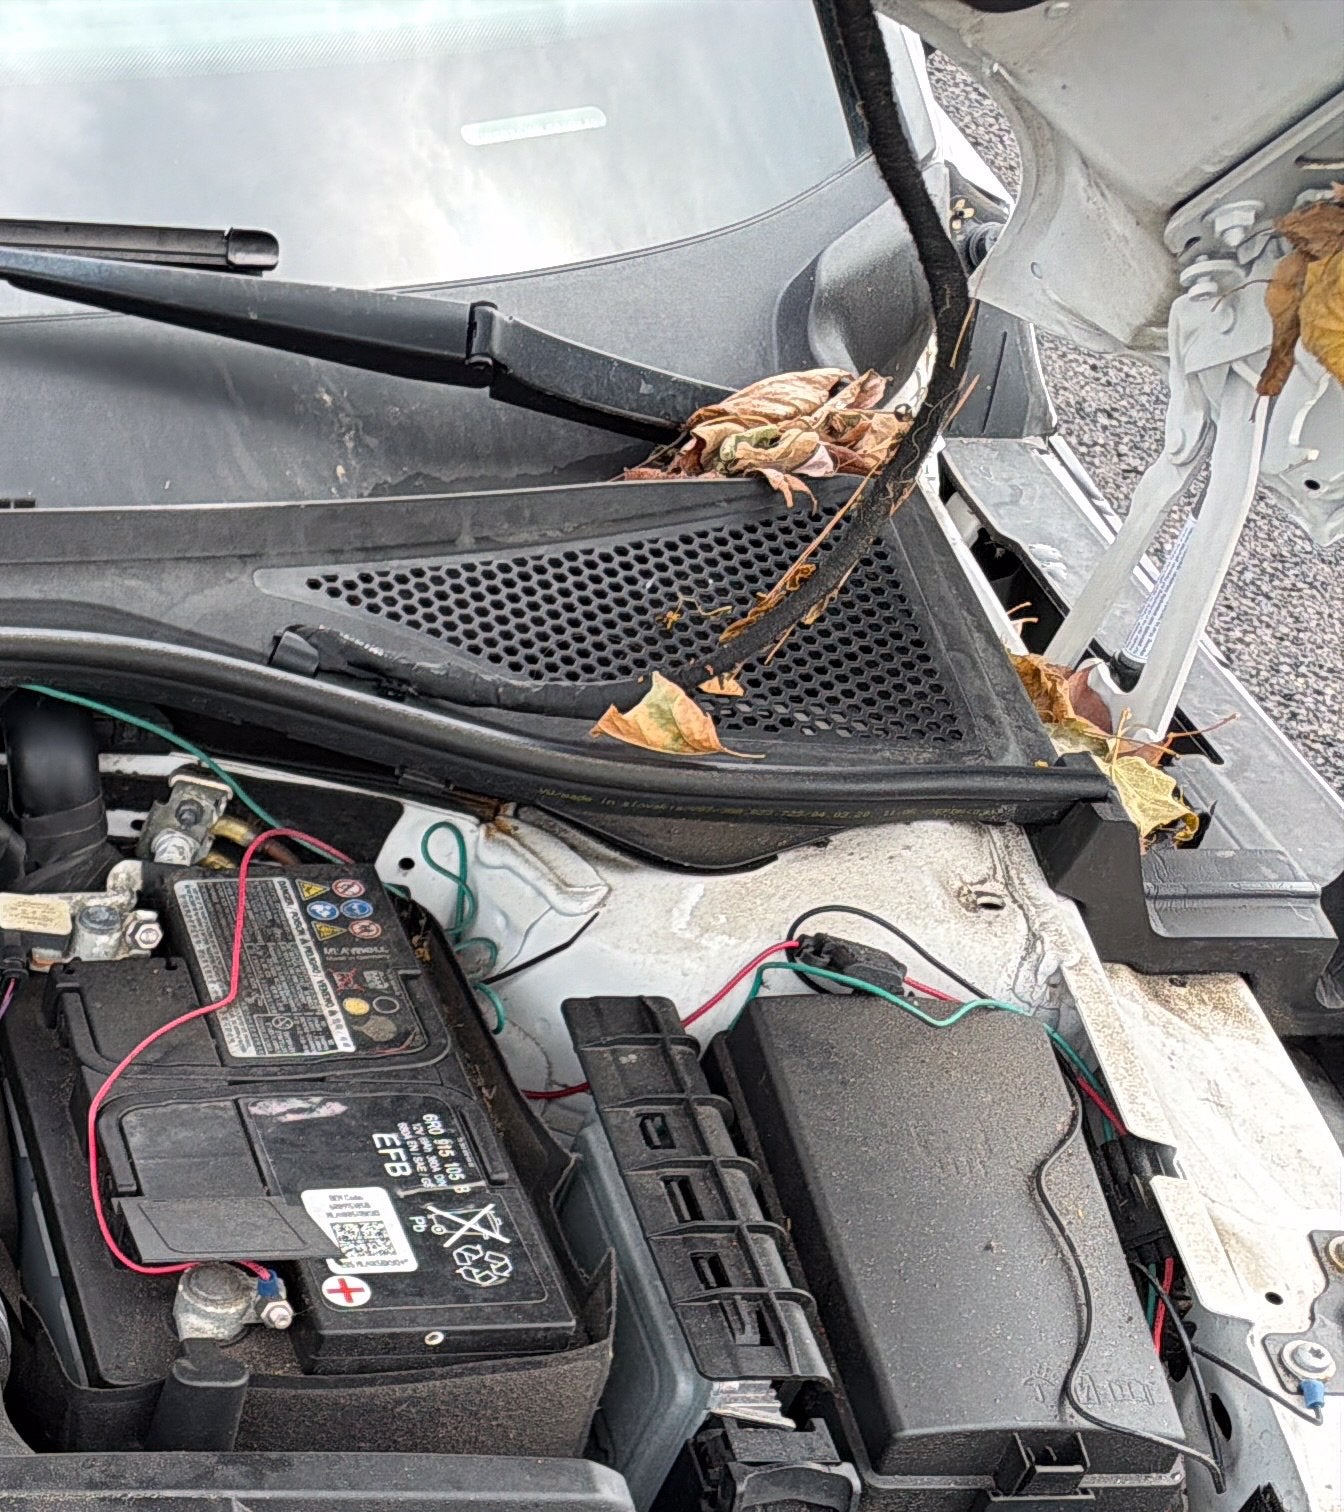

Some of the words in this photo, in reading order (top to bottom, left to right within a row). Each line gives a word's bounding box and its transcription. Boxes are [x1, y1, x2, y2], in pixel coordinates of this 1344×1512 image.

[372, 1133, 412, 1177] EFB
[423, 1113, 445, 1136] 6R0
[435, 1138, 455, 1158] 915
[445, 1162, 466, 1182] 105
